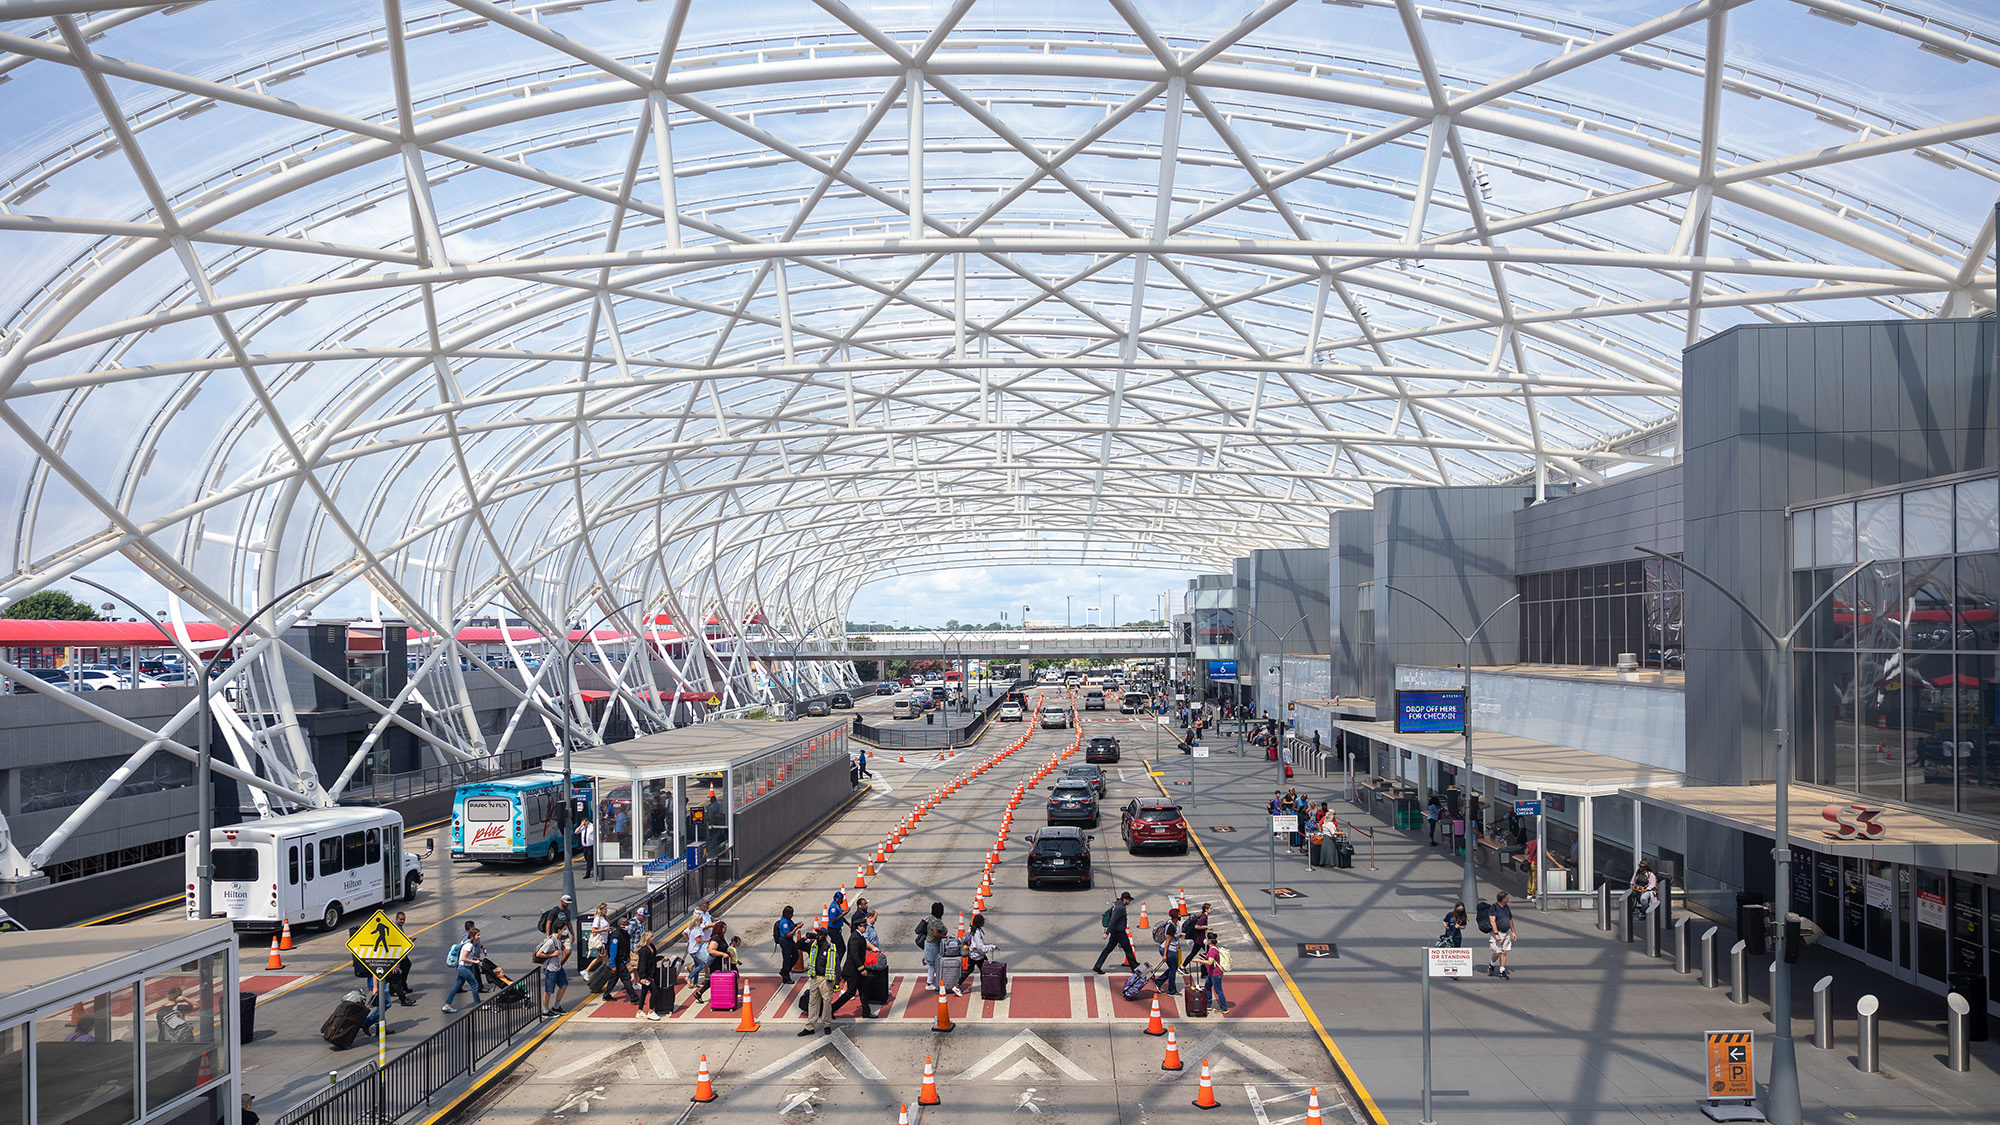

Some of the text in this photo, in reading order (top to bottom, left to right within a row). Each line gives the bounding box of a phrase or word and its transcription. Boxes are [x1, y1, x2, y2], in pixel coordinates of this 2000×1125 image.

[1405, 705, 1457, 713] DROP OFF HERE
[1822, 804, 1886, 840] S3
[471, 822, 506, 846] plus
[1899, 870, 1910, 883] S3
[343, 879, 362, 890] Hilton
[224, 890, 248, 898] Hilton
[1732, 1066, 1744, 1080] P
